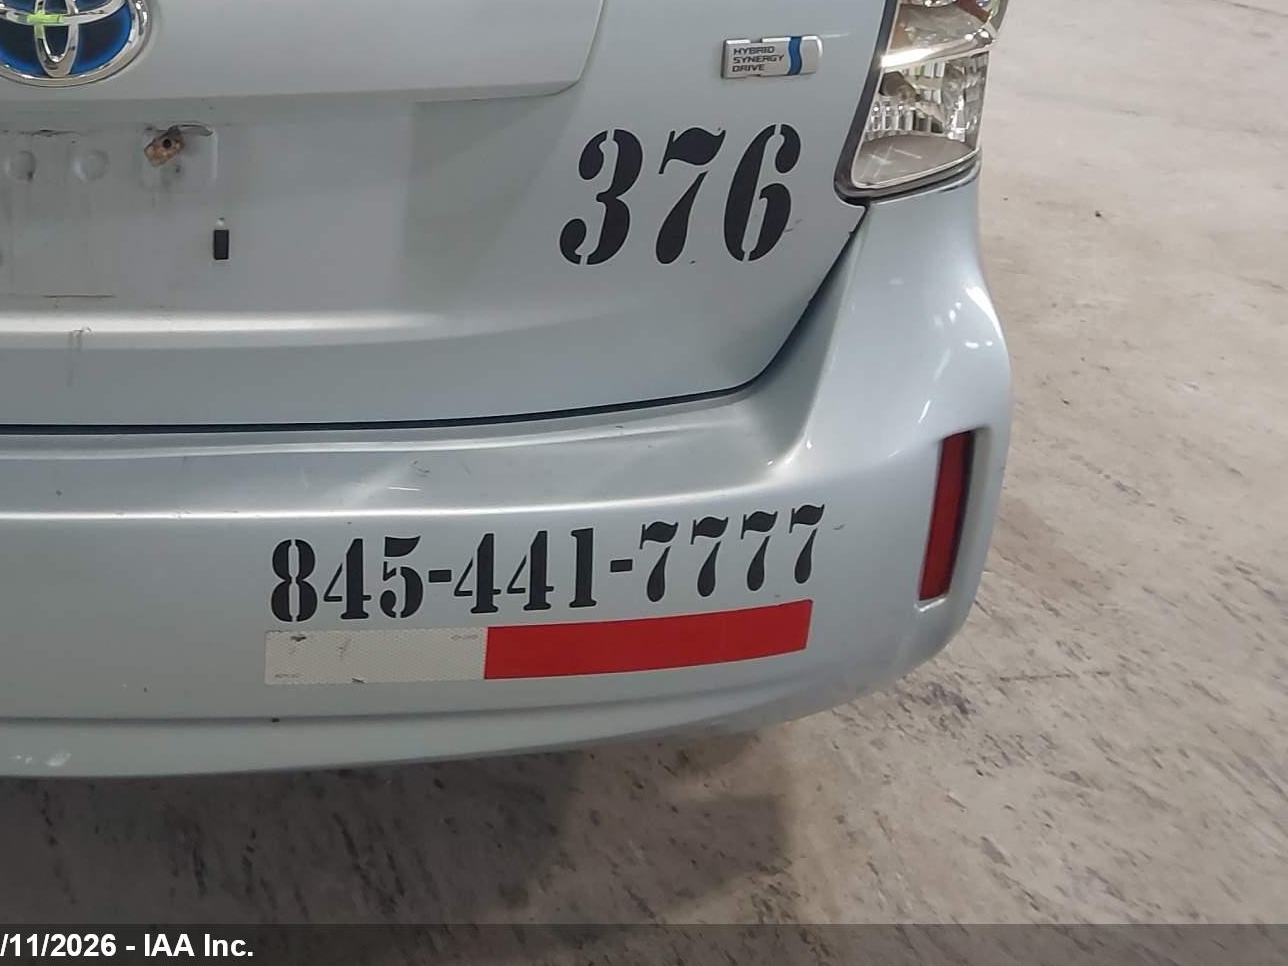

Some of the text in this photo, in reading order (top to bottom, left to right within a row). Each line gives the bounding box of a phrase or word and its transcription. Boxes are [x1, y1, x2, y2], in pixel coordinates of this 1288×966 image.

[733, 46, 775, 55] HYBRID
[733, 54, 785, 64] SYNERGY
[732, 64, 766, 72] DRIVE
[559, 123, 801, 266] 376
[270, 504, 825, 624] 845-441-7777
